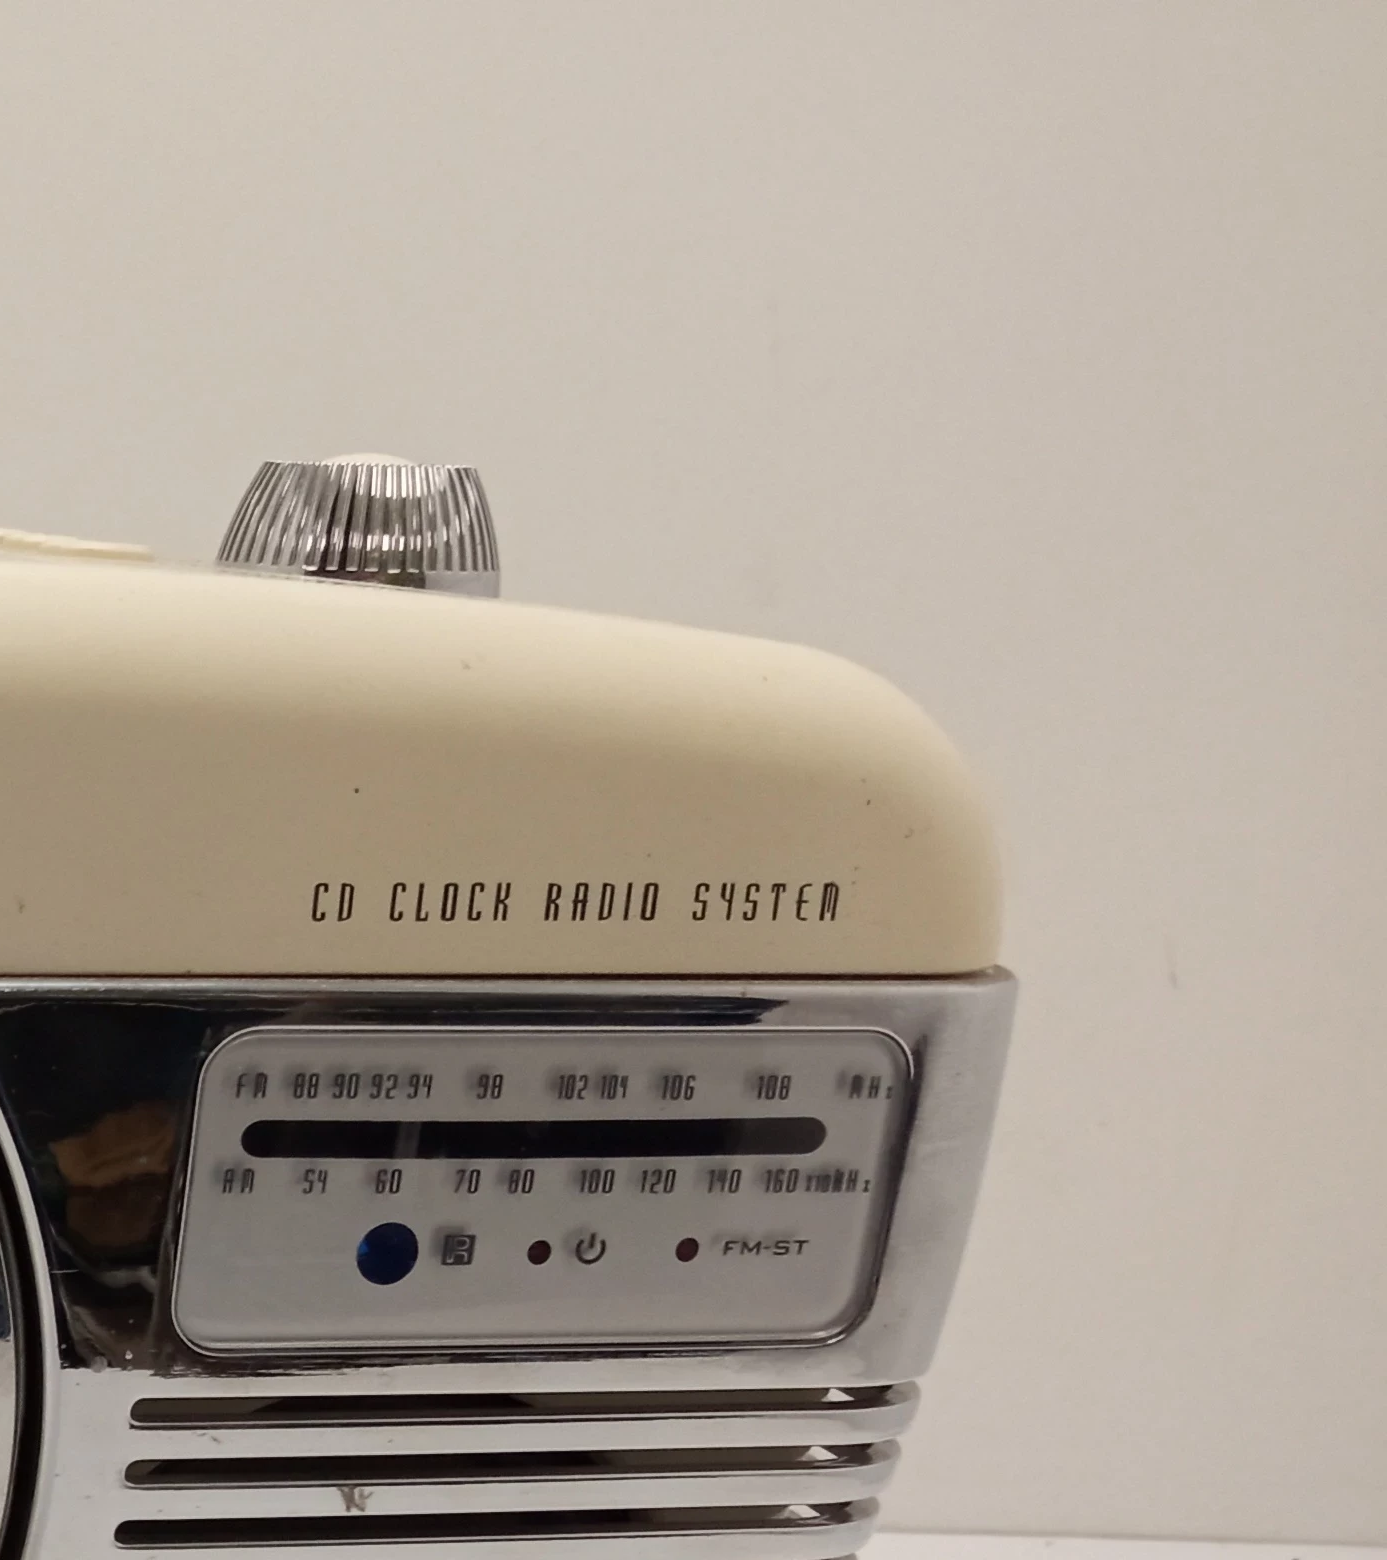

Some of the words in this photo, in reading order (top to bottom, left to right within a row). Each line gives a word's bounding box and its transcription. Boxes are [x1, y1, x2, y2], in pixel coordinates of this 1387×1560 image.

[312, 882, 355, 922] CD
[389, 882, 511, 922] CLOCK
[544, 882, 659, 922] RADIO
[692, 882, 840, 922] SYSTEM
[235, 1072, 268, 1099] FM
[293, 1072, 320, 1099] 88
[332, 1072, 361, 1099] 90
[369, 1073, 398, 1099] 92
[407, 1073, 433, 1099] 94
[477, 1073, 504, 1099] 98
[558, 1074, 589, 1099] 102
[600, 1074, 629, 1099] 104
[661, 1074, 696, 1100] 106
[757, 1075, 792, 1100] 108
[222, 1167, 255, 1194] AM
[302, 1168, 328, 1194] 54
[376, 1168, 403, 1194] 60
[453, 1168, 481, 1194] 70
[507, 1168, 535, 1194] 80
[579, 1168, 616, 1194] 100
[639, 1168, 677, 1194] 120
[707, 1168, 743, 1194] 140
[765, 1168, 800, 1194] 160
[722, 1239, 809, 1257] FM-ST
